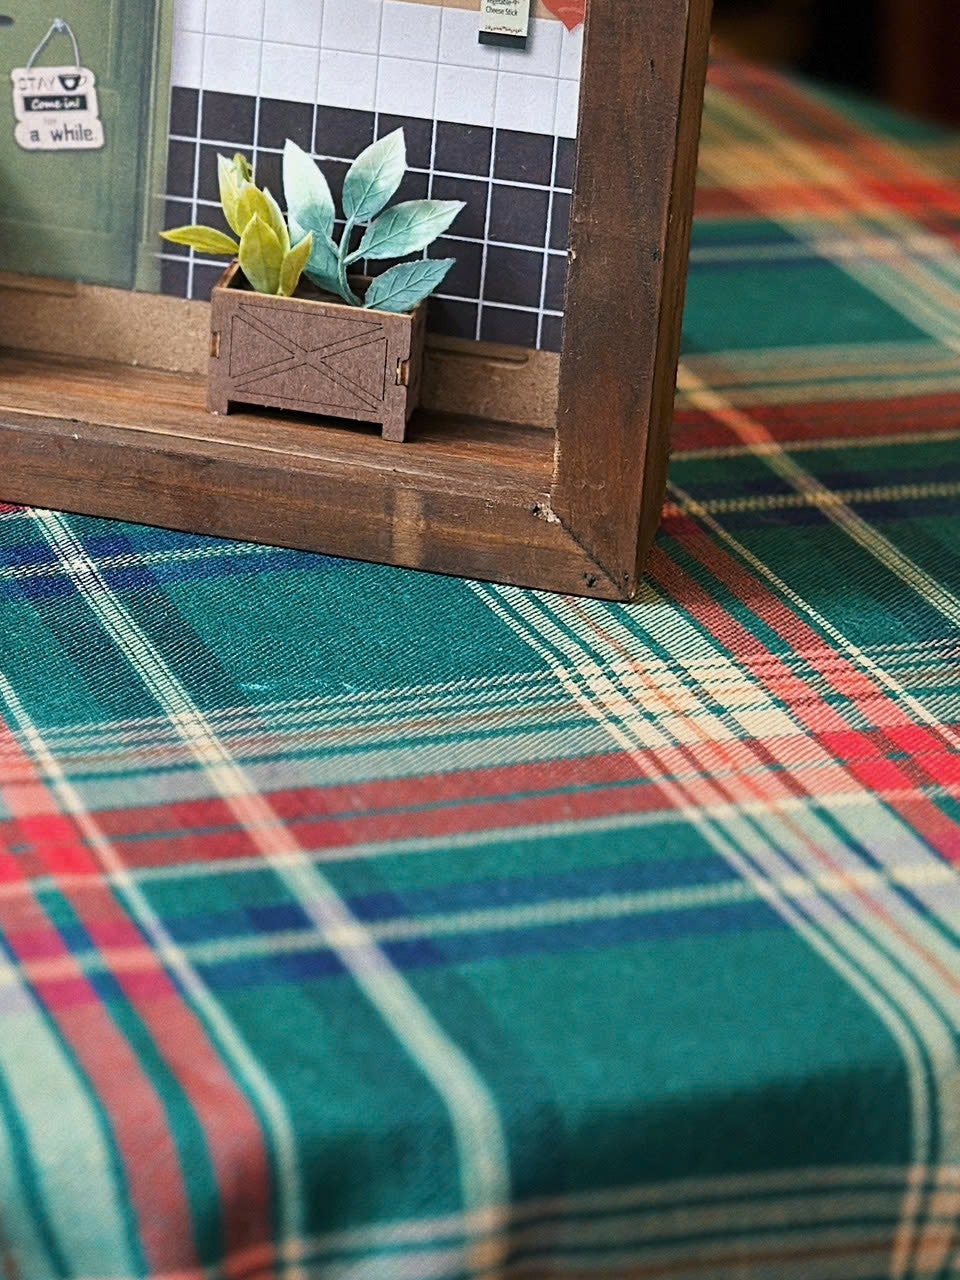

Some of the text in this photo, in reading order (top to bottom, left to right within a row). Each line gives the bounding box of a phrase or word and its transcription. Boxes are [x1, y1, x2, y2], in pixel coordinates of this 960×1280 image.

[485, 6, 518, 17] Cheese Stick
[17, 76, 56, 91] STAY
[30, 98, 61, 110] Come
[29, 123, 93, 142] a while
